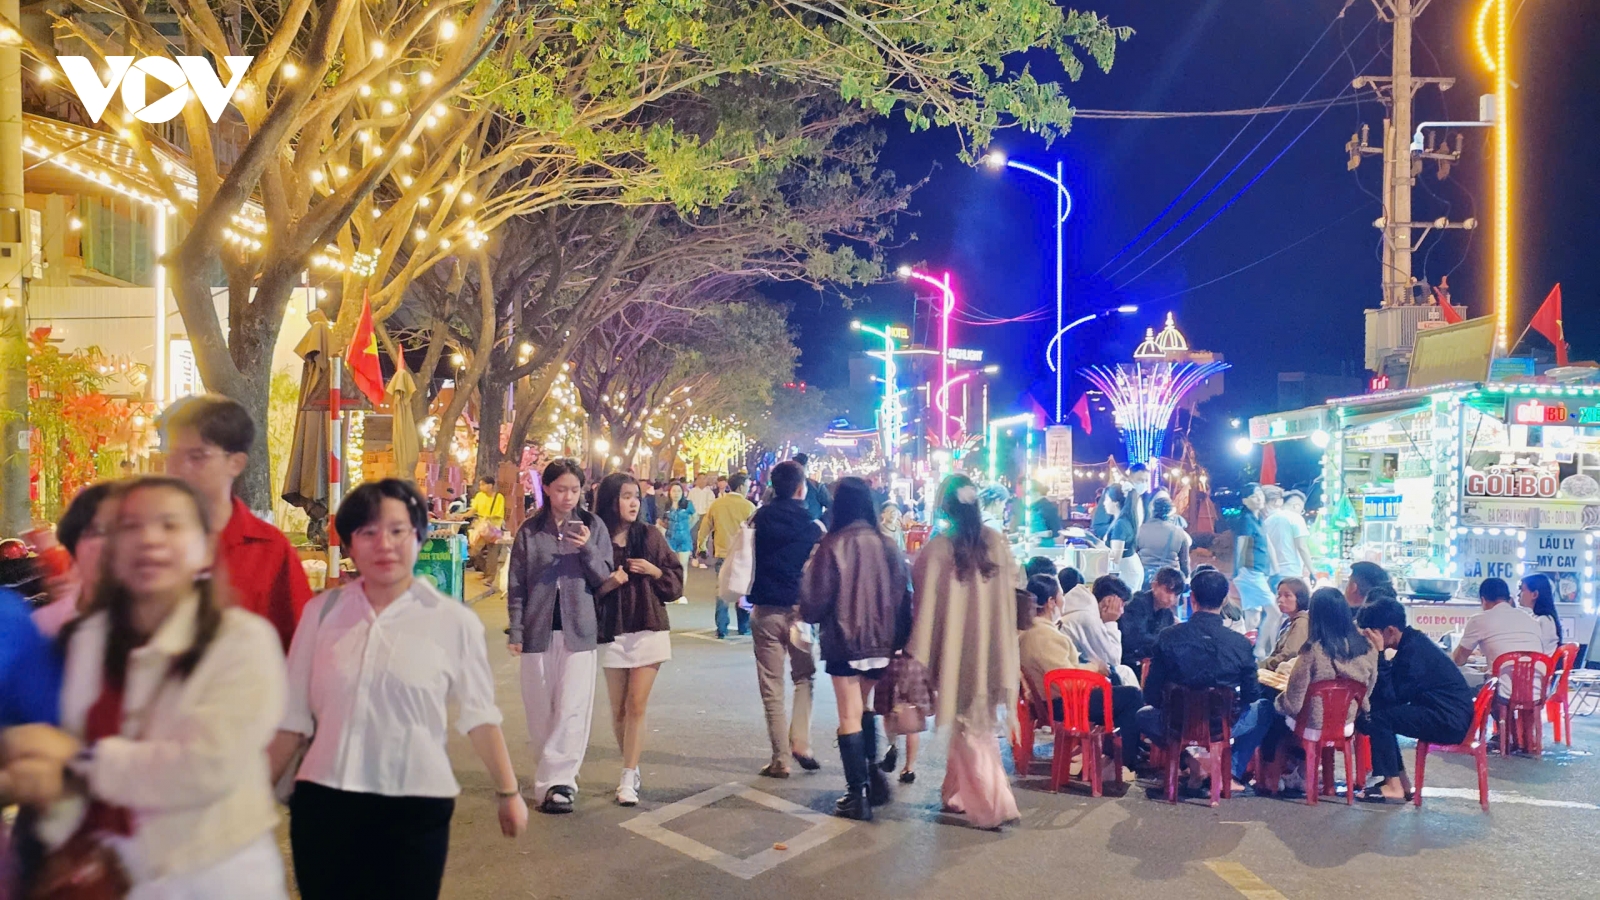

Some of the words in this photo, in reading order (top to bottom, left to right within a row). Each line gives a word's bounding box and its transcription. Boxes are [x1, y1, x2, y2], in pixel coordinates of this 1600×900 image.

[1467, 468, 1515, 496] GỎI
[1519, 471, 1557, 497] BÒ
[1563, 538, 1575, 550] LY
[1464, 558, 1482, 578] GÀ
[1487, 562, 1513, 578] KFC
[1557, 555, 1577, 568] CAY
